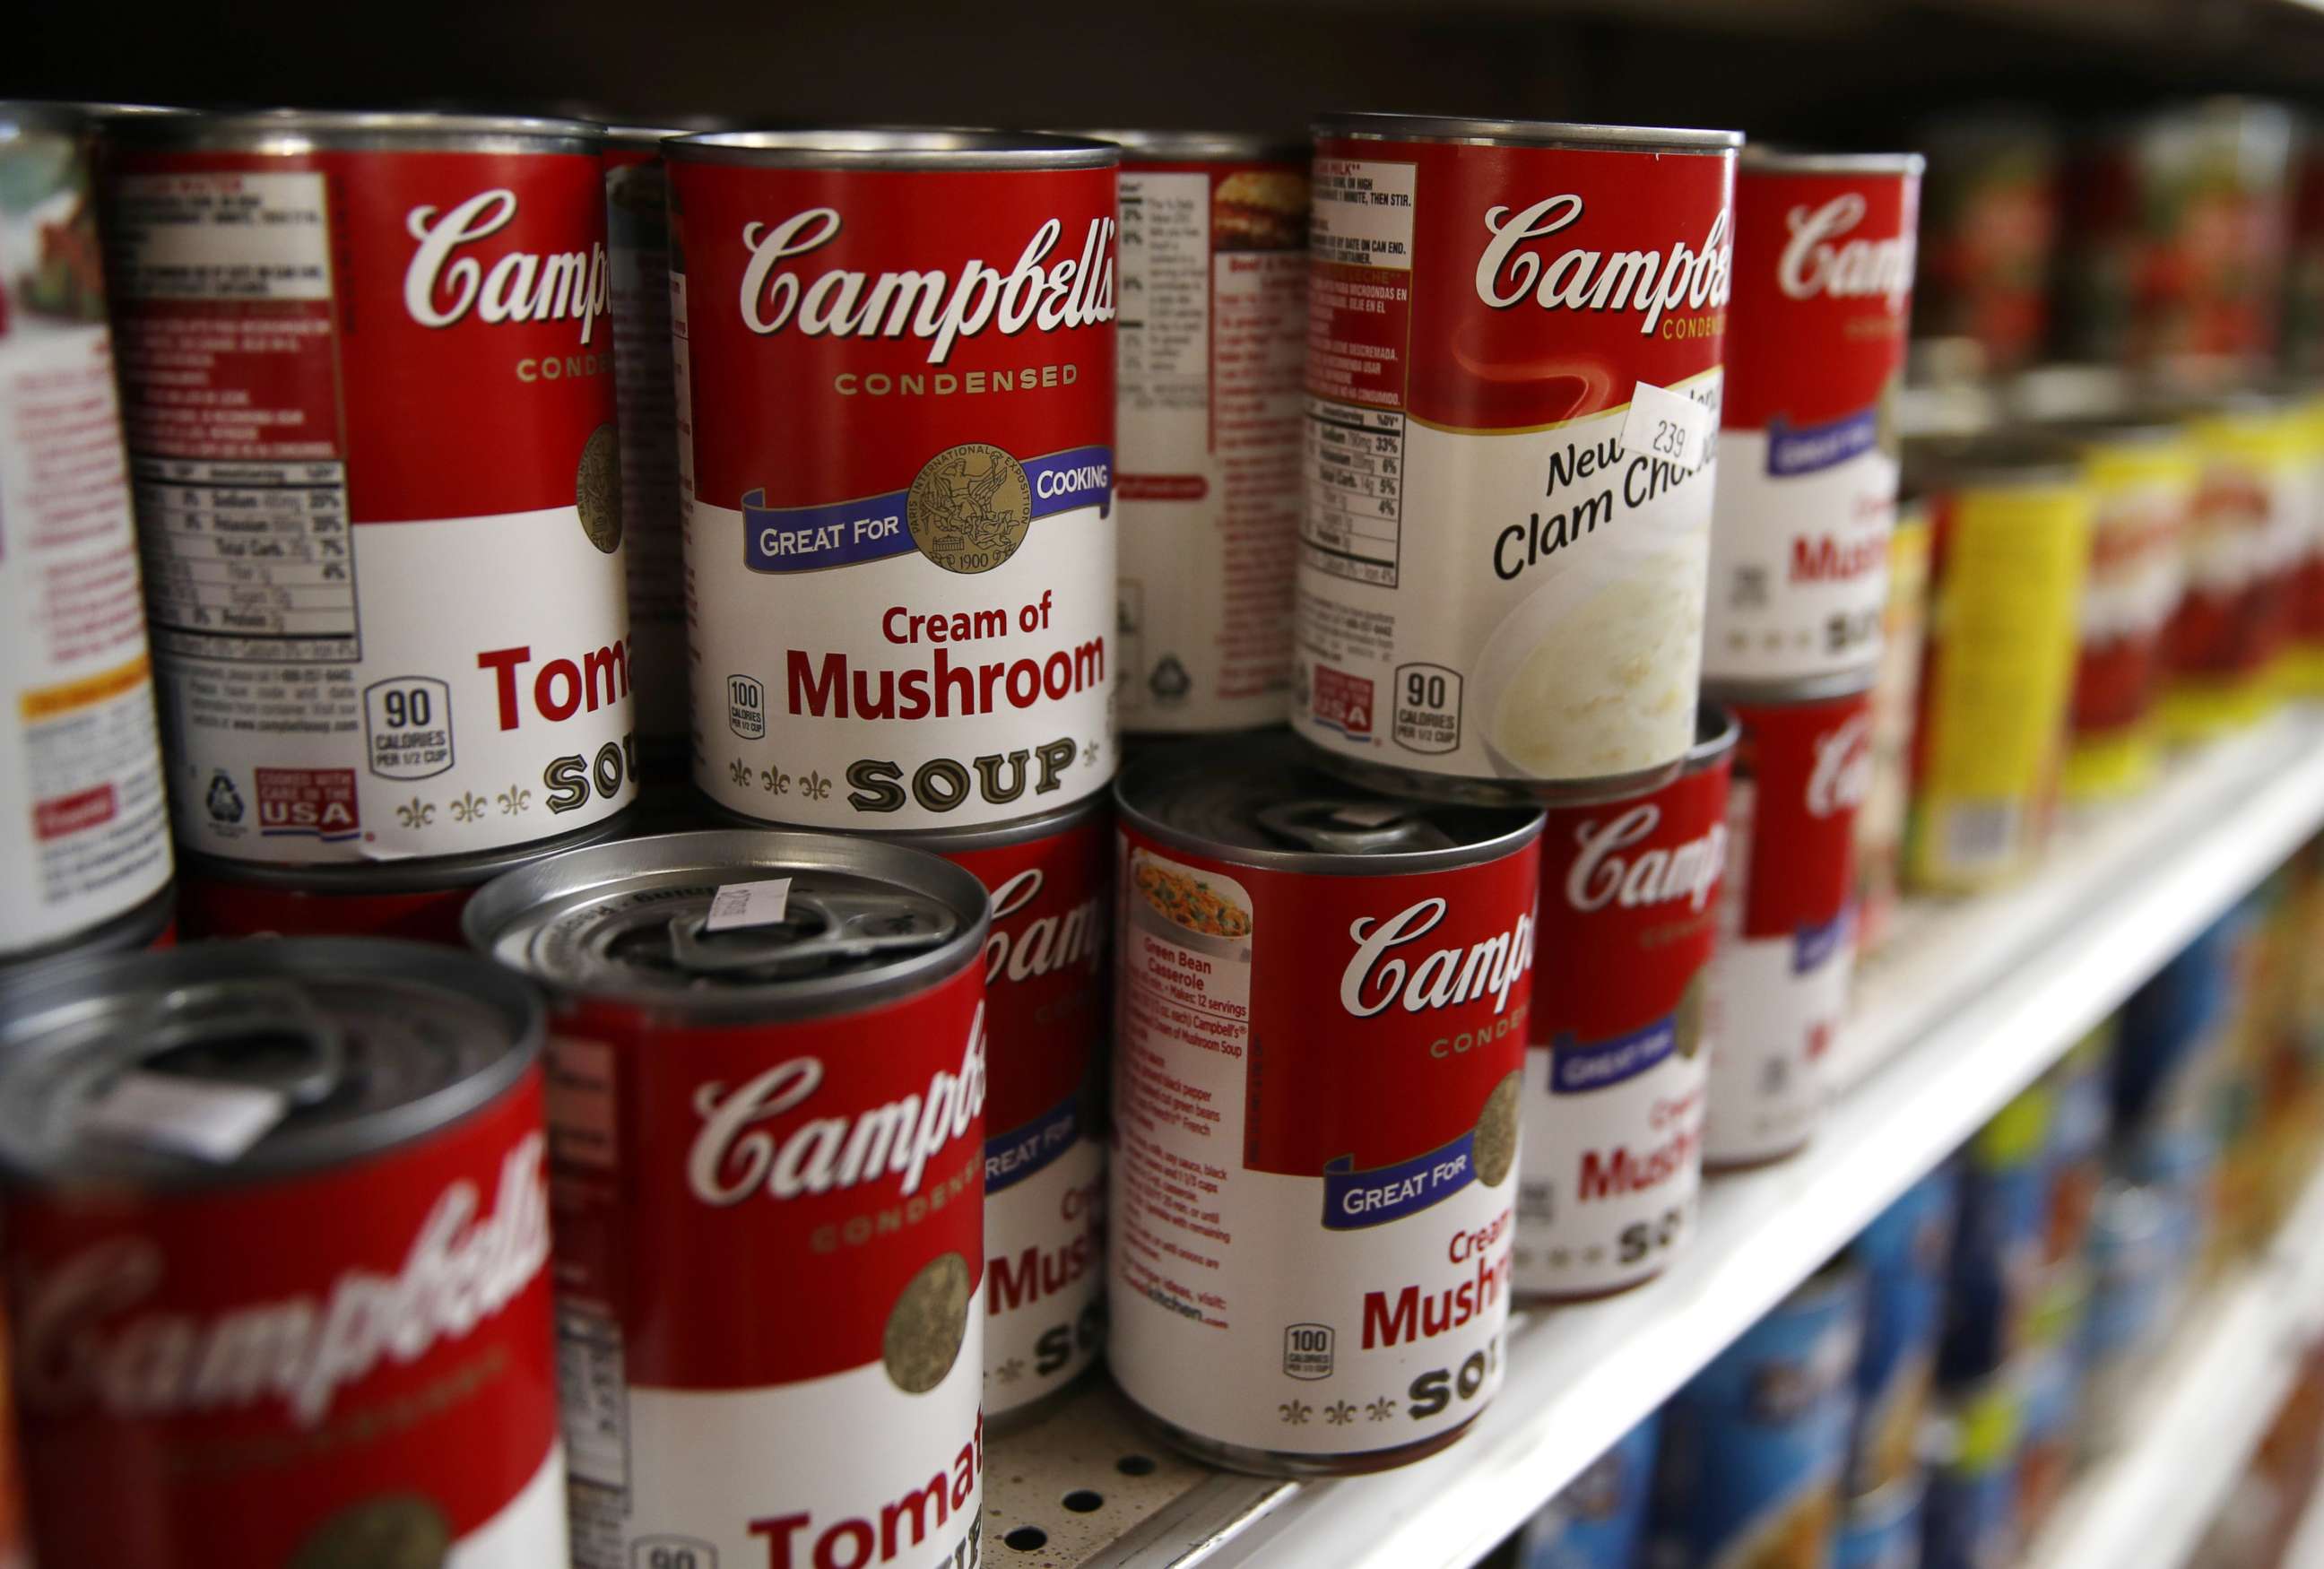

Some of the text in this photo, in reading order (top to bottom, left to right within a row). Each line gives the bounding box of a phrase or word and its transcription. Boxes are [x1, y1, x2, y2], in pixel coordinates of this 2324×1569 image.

[1369, 191, 1389, 206] THEN
[1390, 193, 1412, 208] STIR.
[1371, 239, 1387, 254] CAN
[1388, 241, 1407, 256] END.
[403, 188, 614, 345] Camp
[739, 206, 1117, 364] Campbell's
[1396, 287, 1408, 302] EN
[1376, 300, 1386, 315] EL
[834, 364, 1078, 395] CONDENSED
[1375, 436, 1399, 454] 33%
[1652, 419, 1686, 459] 239
[912, 445, 991, 495] INTERNATIONAL
[1003, 455, 1031, 525] EXPOSITION
[759, 464, 1109, 559] GREAT FOR COOKING
[1493, 489, 1614, 581] Clam
[960, 552, 990, 570] 1900
[881, 590, 1054, 646] Cream of
[477, 629, 632, 732] Tom
[786, 635, 1106, 722] Mushroom
[1407, 672, 1445, 709] 90
[731, 680, 758, 708] 100
[384, 688, 431, 729] 90
[731, 706, 761, 723] CALORIES
[1399, 709, 1456, 731] CALORIES
[375, 730, 447, 750] CALORIES
[1397, 725, 1416, 740] PER
[1434, 729, 1457, 744] CUP
[376, 752, 401, 767] PER
[423, 748, 447, 764] CUP
[845, 736, 1078, 813] SOUP
[261, 802, 353, 825] USA
[1144, 936, 1212, 975] Green Bean
[1147, 956, 1205, 993] Casserole
[1197, 993, 1208, 1008] 12
[1209, 997, 1247, 1019] servings
[1220, 1039, 1244, 1060] Soup
[1182, 1084, 1212, 1104] pepper
[1195, 1102, 1221, 1123] beans
[1203, 1163, 1227, 1182] black
[1343, 1153, 1468, 1215] GREAT FOR
[1291, 1330, 1327, 1352] 100
